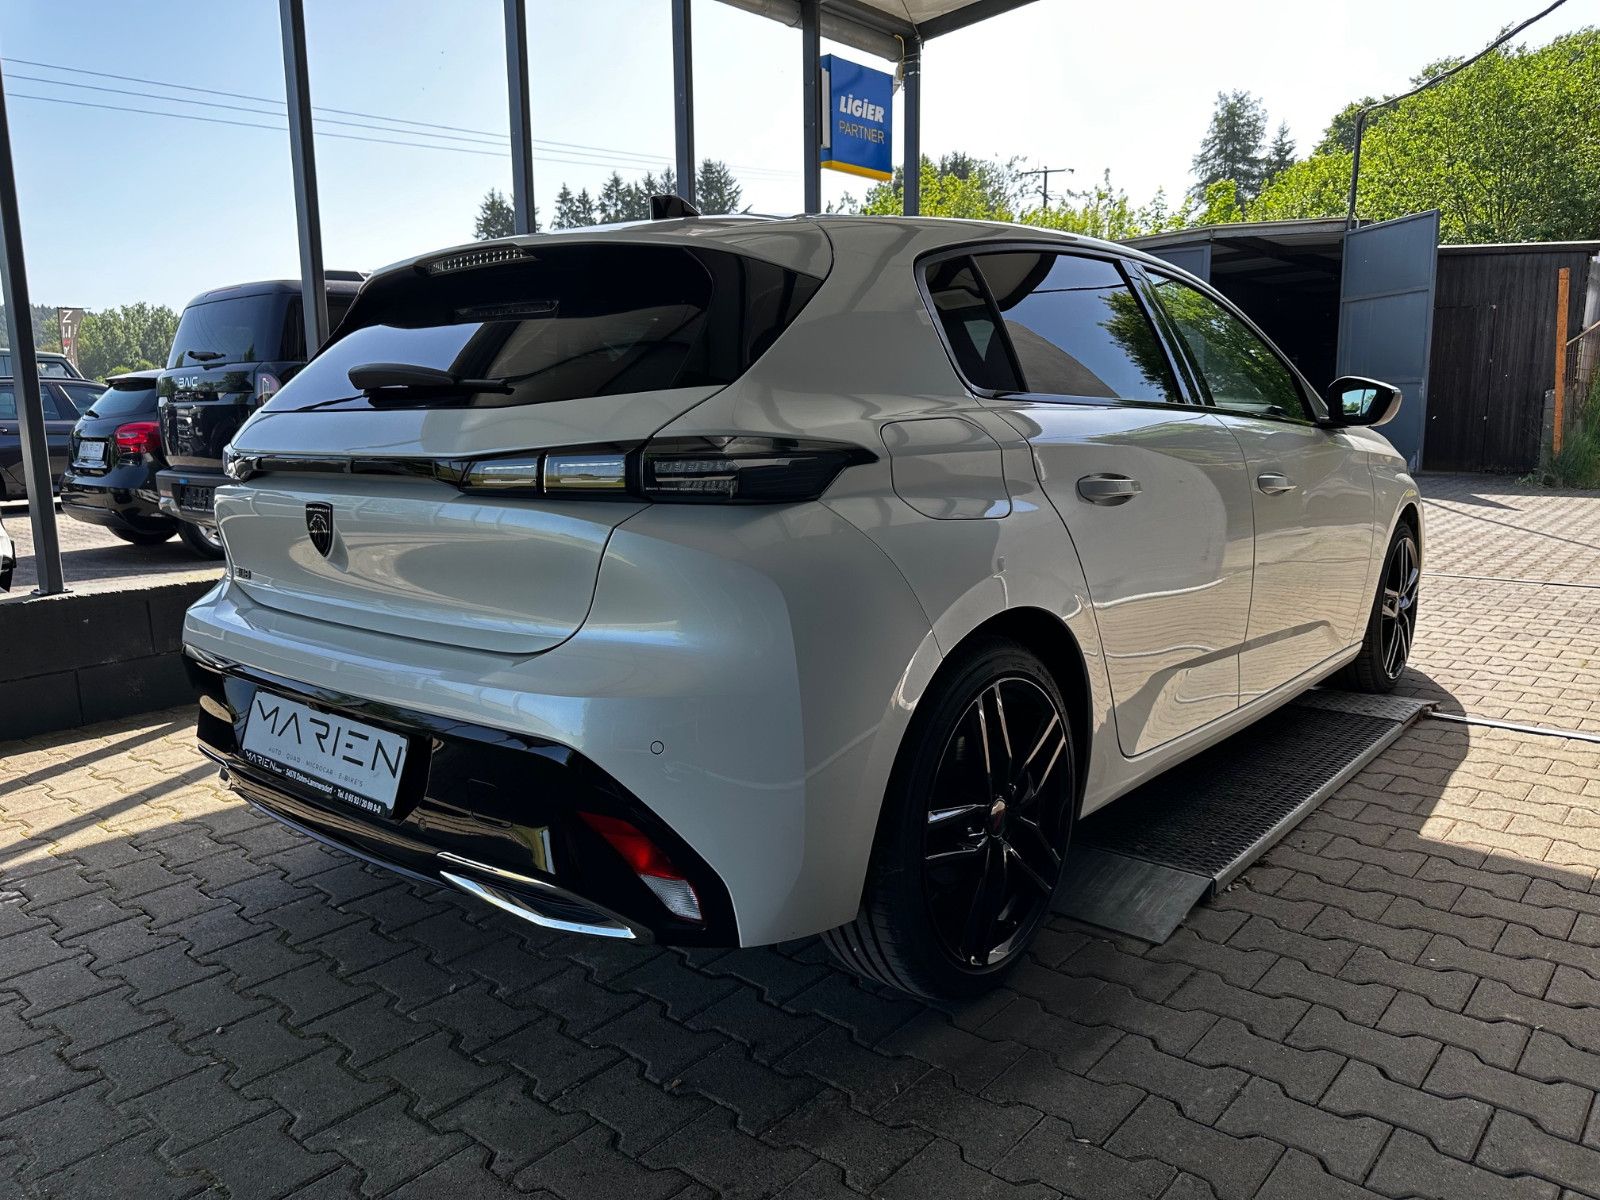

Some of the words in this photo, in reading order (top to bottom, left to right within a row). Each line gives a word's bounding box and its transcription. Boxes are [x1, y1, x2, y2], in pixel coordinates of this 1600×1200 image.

[839, 120, 885, 144] PARTNER
[257, 699, 403, 779] MARIEN
[245, 750, 276, 770] MARIEN
[268, 748, 282, 756] AUTO
[286, 753, 301, 763] QUAD
[306, 760, 334, 775] MICROCAR
